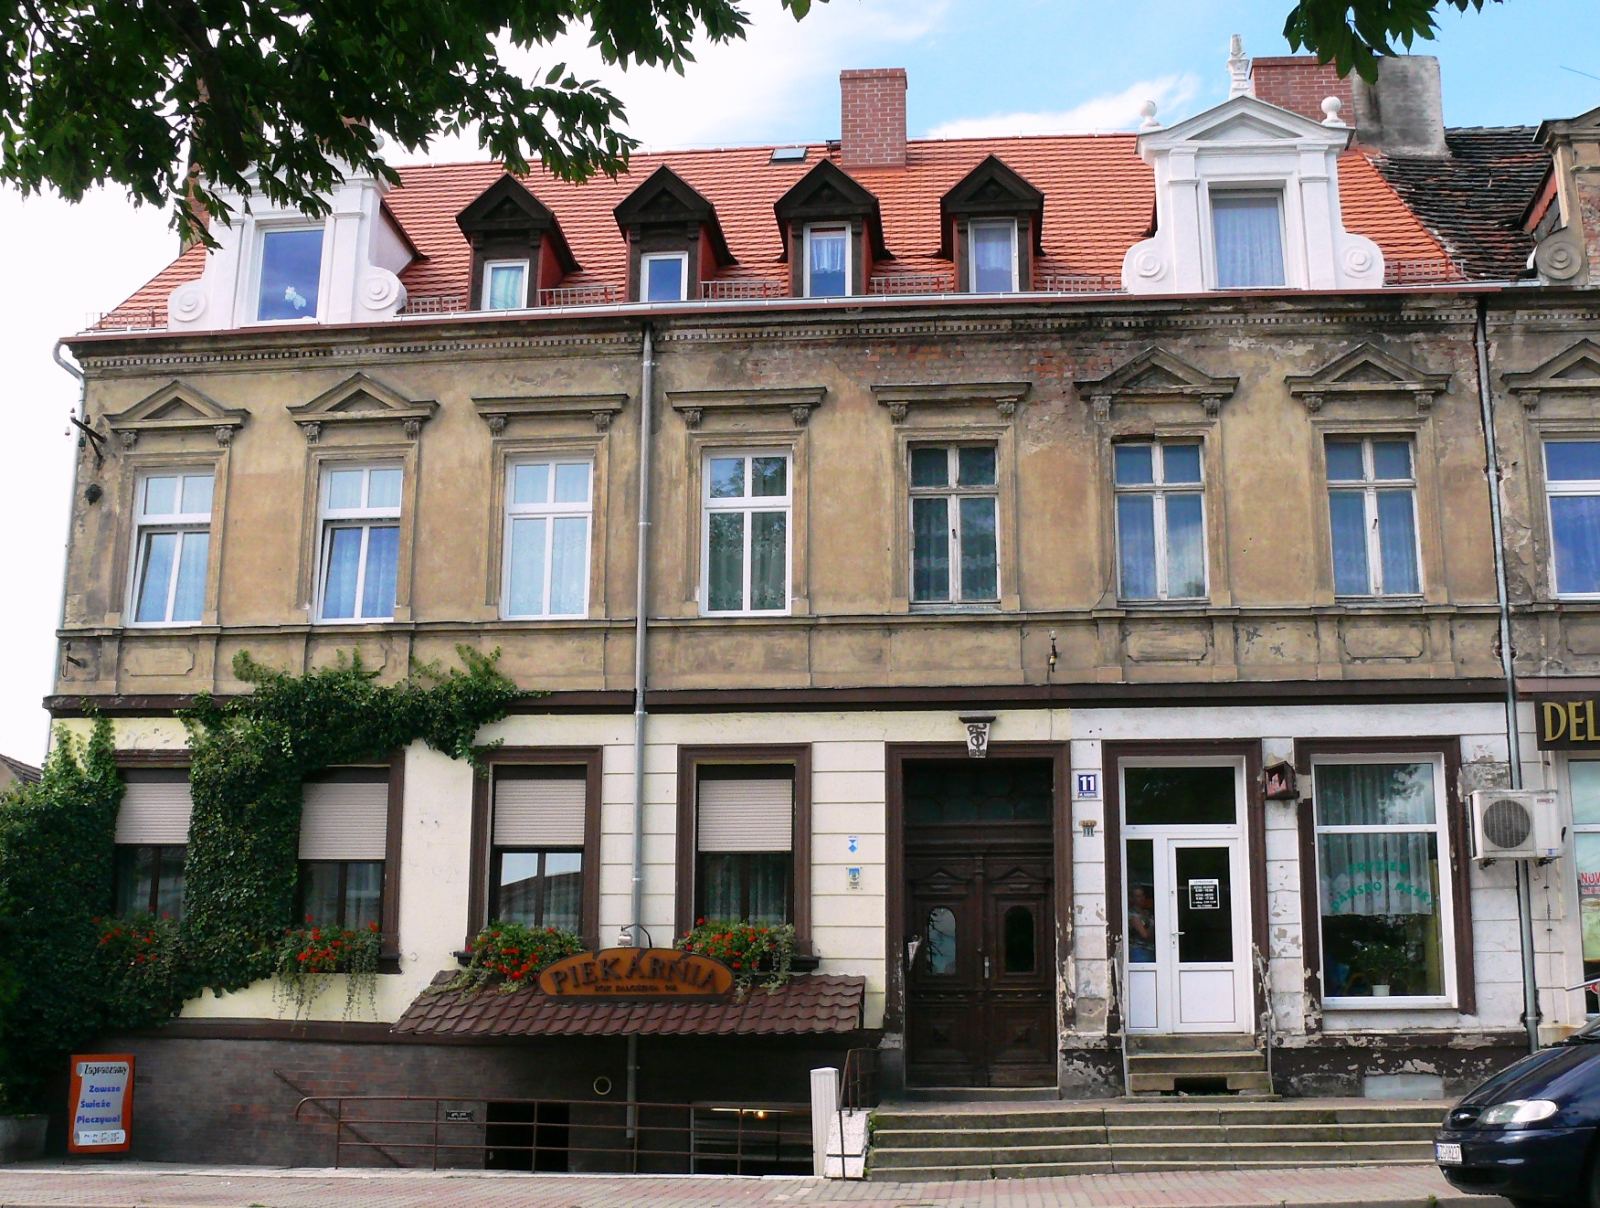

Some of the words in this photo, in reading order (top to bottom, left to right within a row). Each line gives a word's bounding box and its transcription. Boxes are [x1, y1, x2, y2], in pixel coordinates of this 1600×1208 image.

[1542, 700, 1600, 741] DEL
[1080, 776, 1095, 791] 11
[89, 1085, 121, 1093] Zawsze
